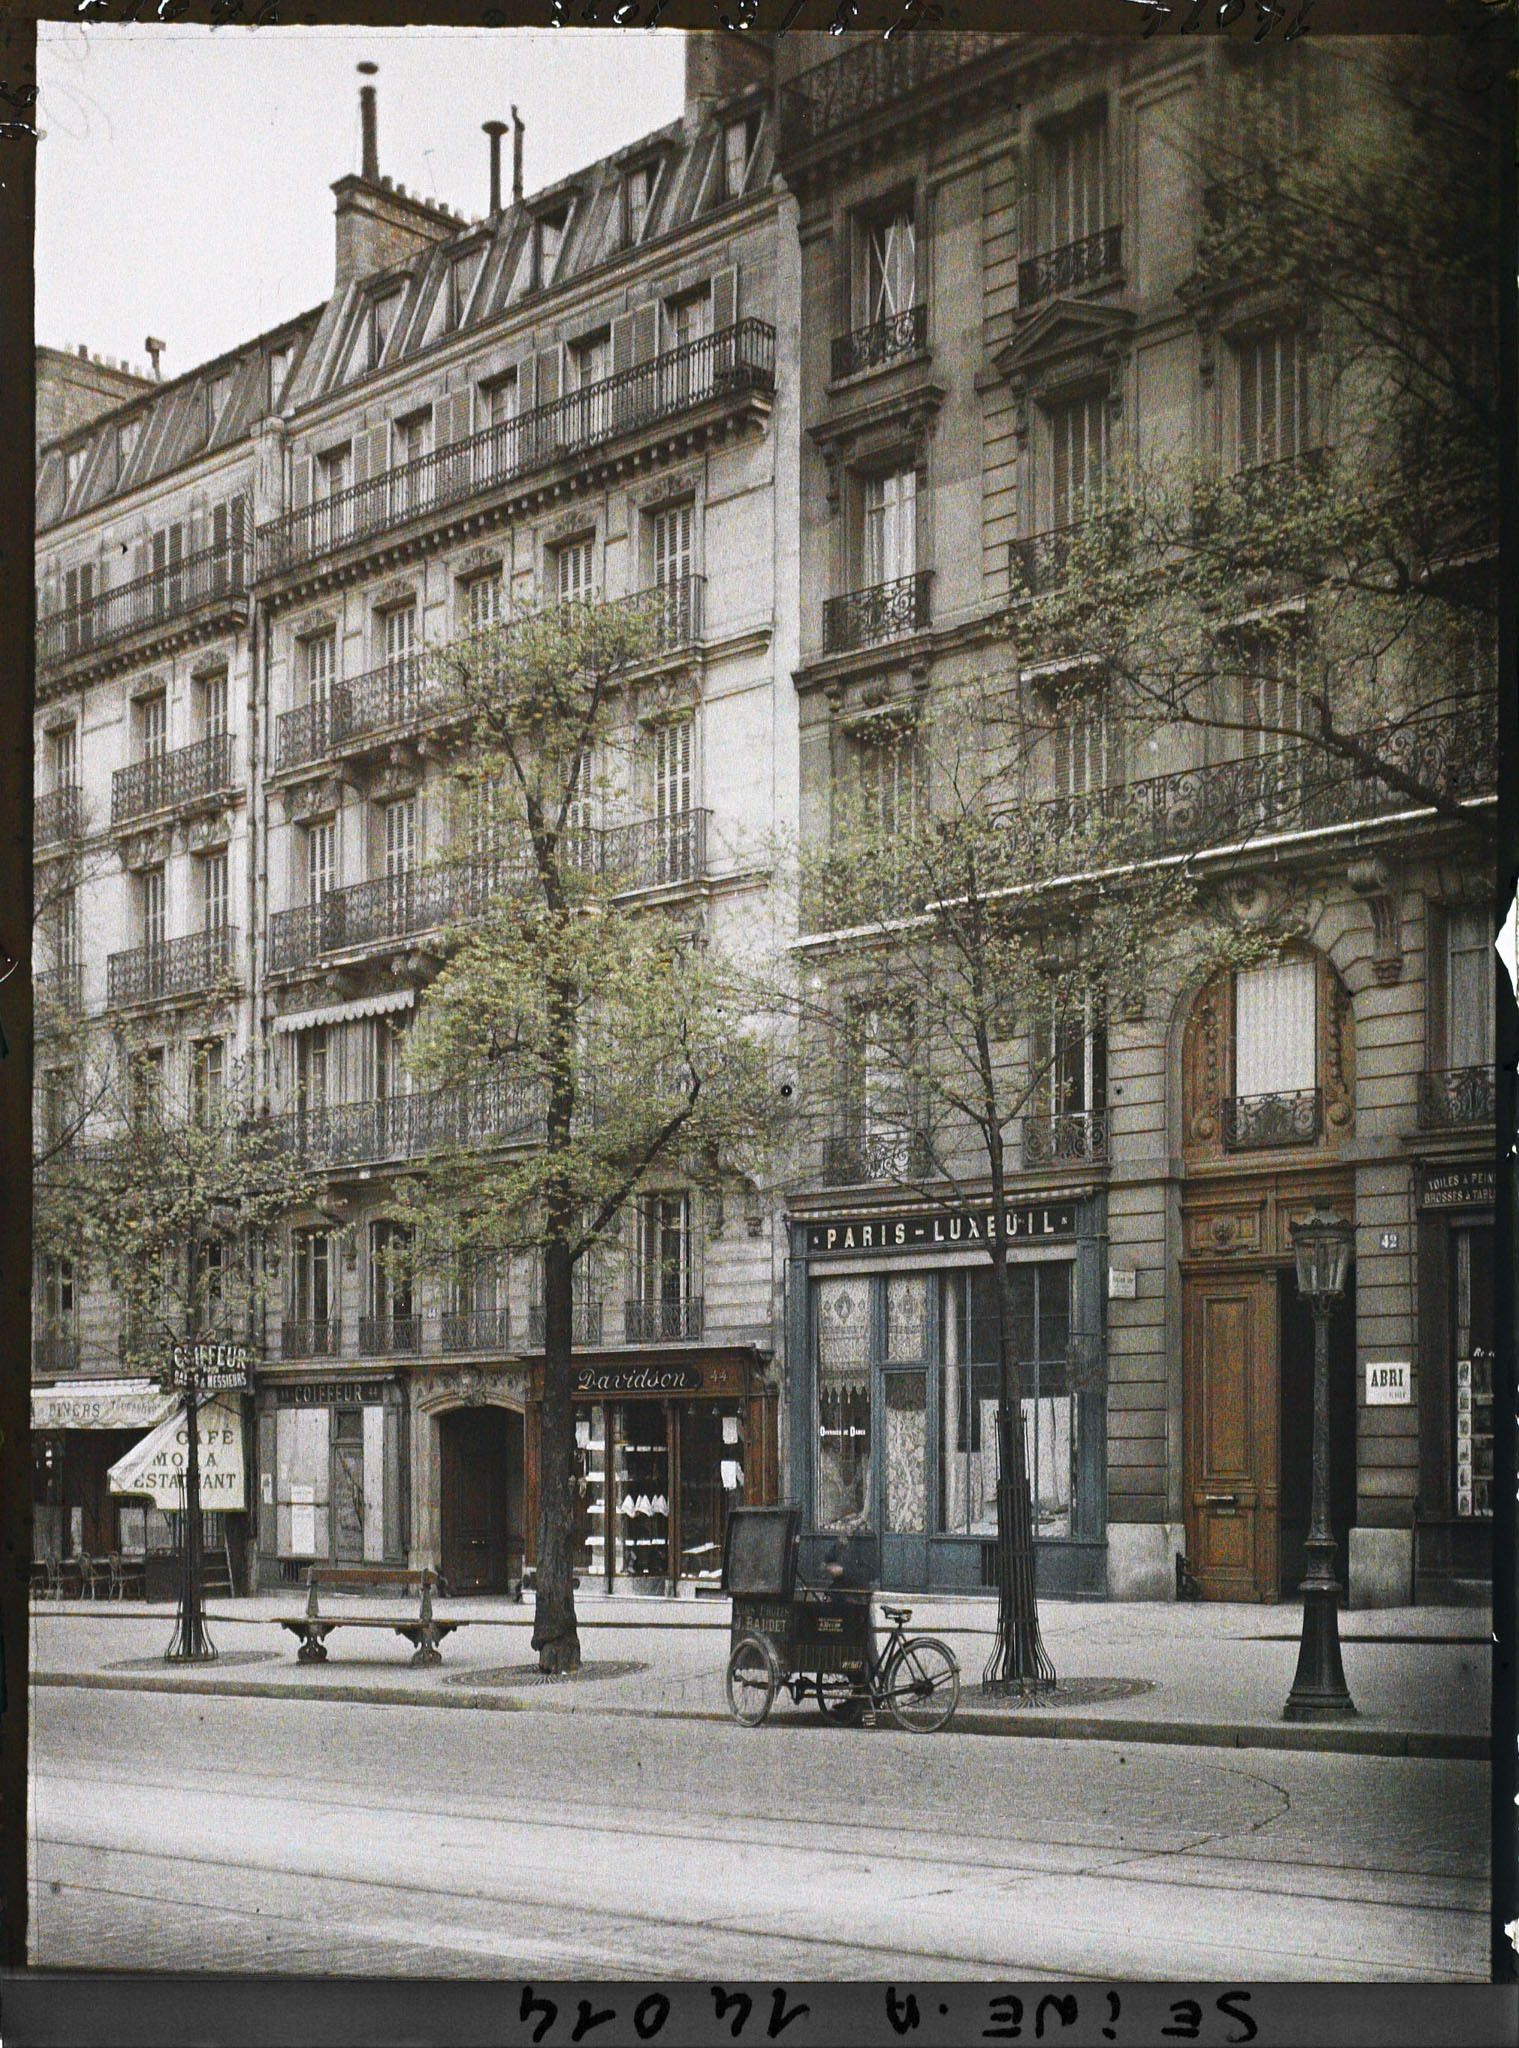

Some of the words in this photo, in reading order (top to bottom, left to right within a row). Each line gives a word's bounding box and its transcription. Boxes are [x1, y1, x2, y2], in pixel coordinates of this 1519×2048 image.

[1428, 1174, 1460, 1191] TOILES
[1425, 1190, 1463, 1204] BROSSES
[1381, 1234, 1398, 1248] 42
[207, 1371, 247, 1388] MESSIEURS
[578, 1368, 687, 1391] Davidson
[1371, 1369, 1404, 1387] ABRI
[295, 1384, 362, 1401] COIFFEUR
[152, 1452, 217, 1467] MOA
